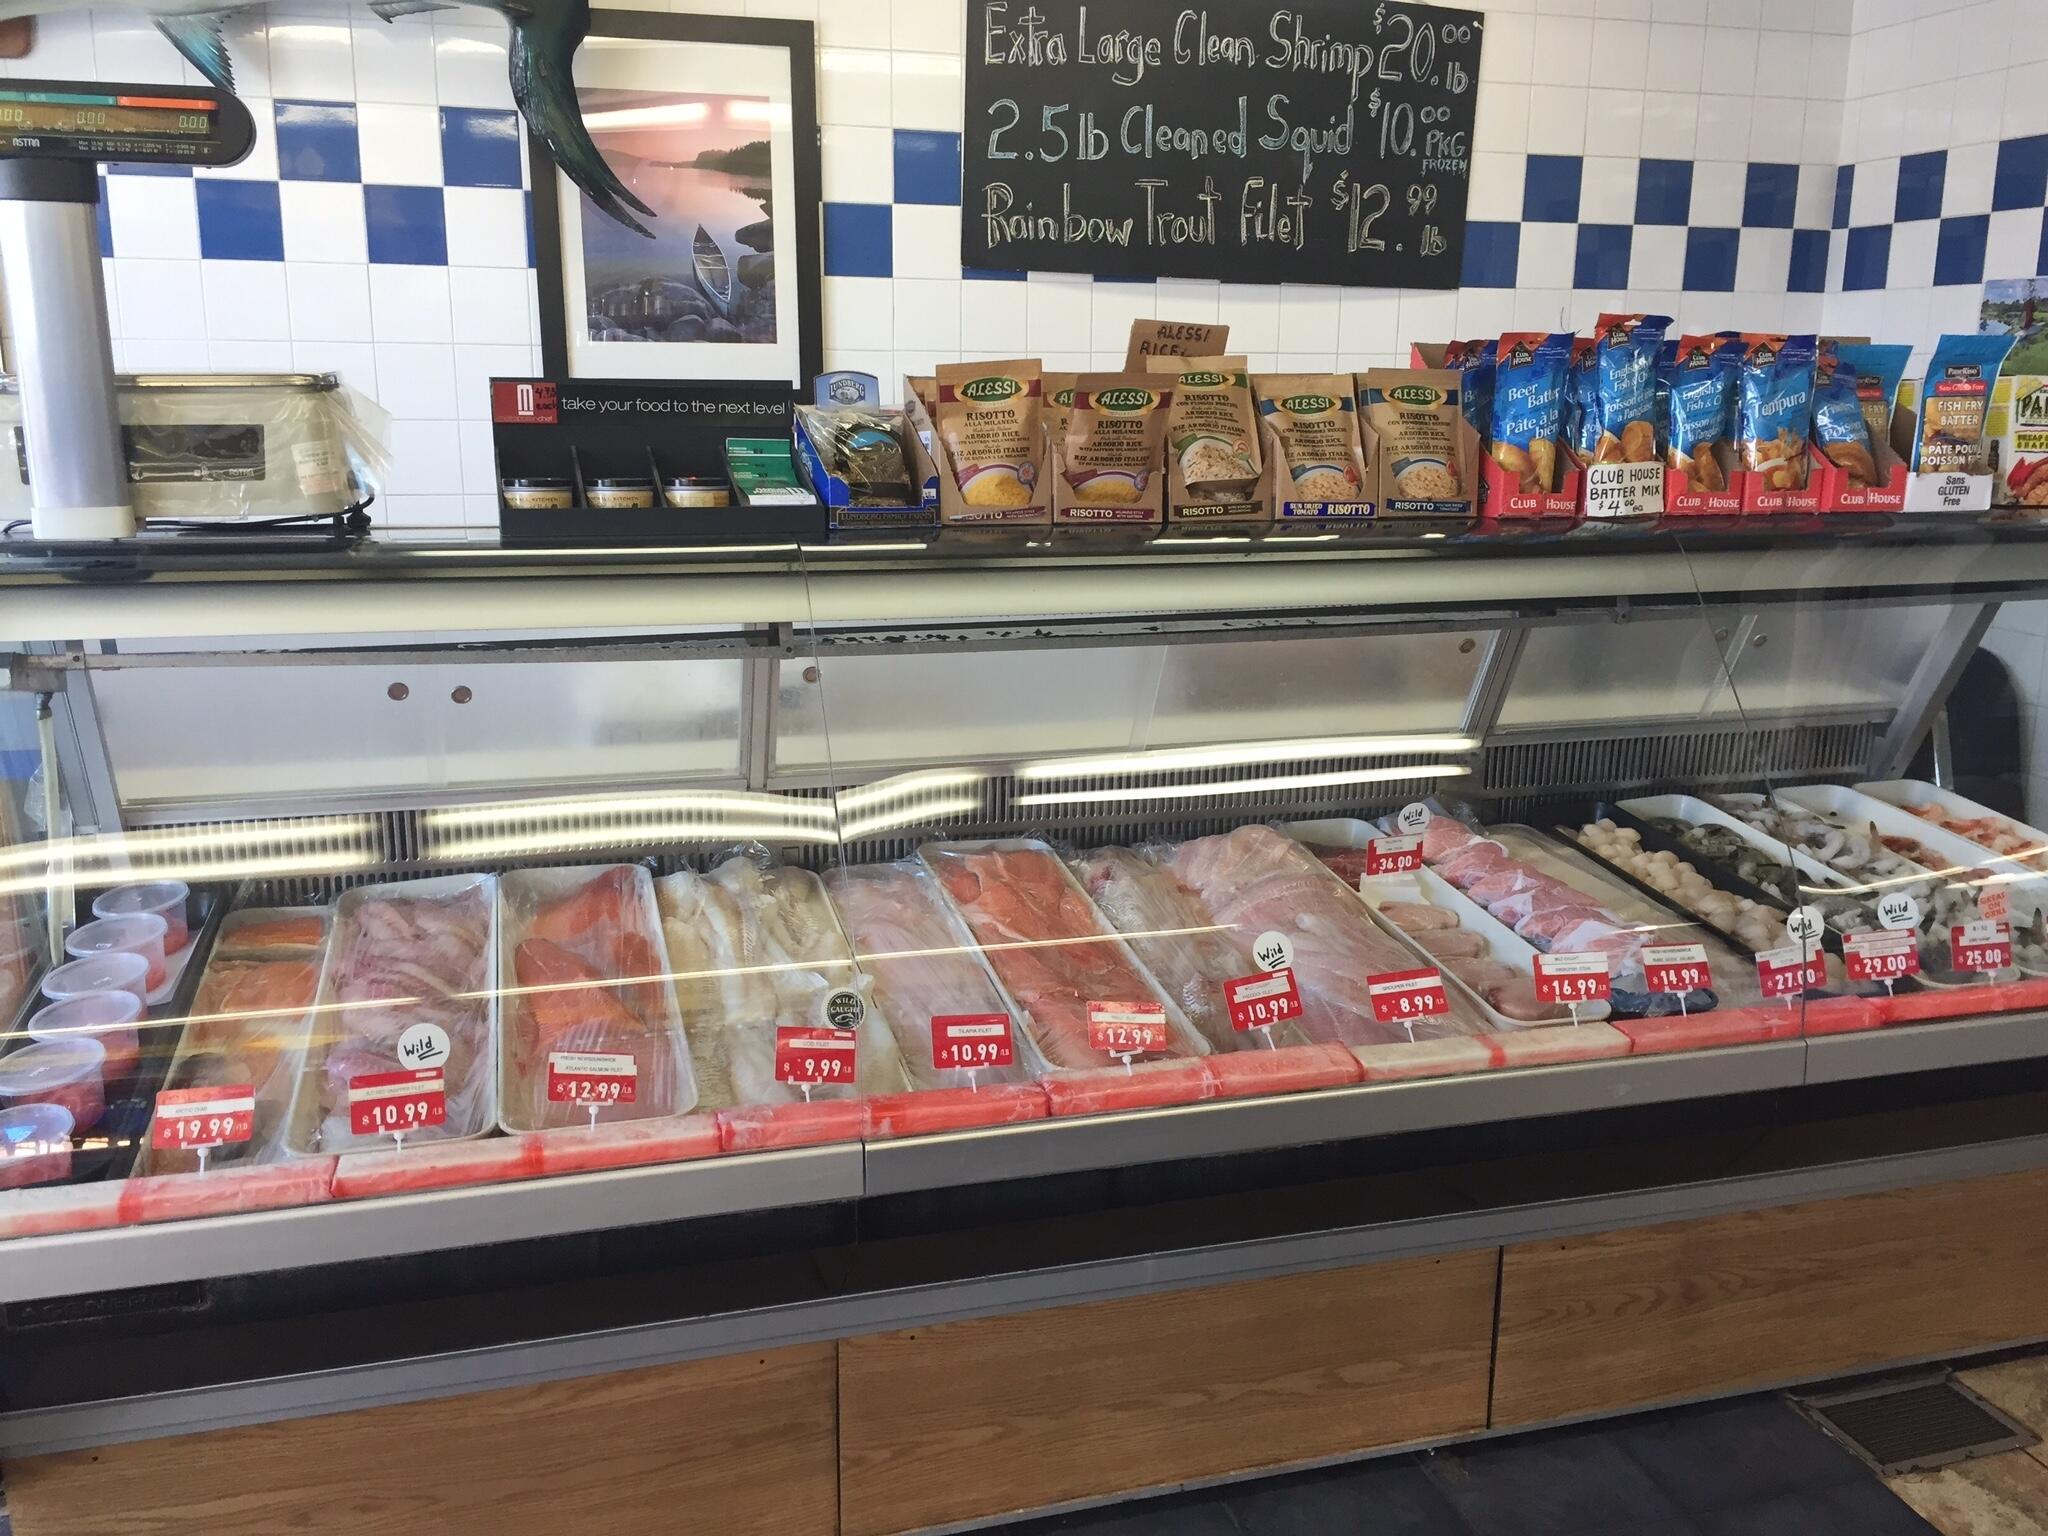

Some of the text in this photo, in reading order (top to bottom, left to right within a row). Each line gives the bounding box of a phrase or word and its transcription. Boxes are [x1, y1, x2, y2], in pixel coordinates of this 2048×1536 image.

[985, 2, 1067, 67] Extra
[1080, 6, 1160, 85] Large
[1173, 10, 1255, 68] Clean
[1265, 10, 1374, 102] Shrimp
[1446, 62, 1469, 93] lb
[1121, 96, 1248, 159] Cleaned
[1258, 94, 1354, 183] Squid
[1421, 159, 1468, 177] FROZEN
[981, 182, 1133, 250] Rainbow
[1135, 178, 1222, 247] Trout
[1240, 176, 1312, 250] Filet
[1419, 225, 1447, 256] lb
[1157, 325, 1210, 342] ALESSI
[1178, 374, 1223, 384] ALESSI
[830, 379, 865, 395] LUNDBERG
[966, 381, 1016, 396] ALESSI
[1508, 384, 1539, 402] Beer
[1101, 392, 1148, 405] ALESSI
[1184, 394, 1230, 402] RISOTTO
[1394, 389, 1435, 401] ALESSI
[1527, 387, 1561, 409] Batter
[562, 397, 785, 415] take your food to the next level
[1286, 398, 1329, 410] ALESSI
[1686, 399, 1704, 412] Fish
[1753, 391, 1806, 418] Tempura
[1938, 401, 1984, 411] FISH FRY
[966, 409, 1015, 421] RISOTTO
[1400, 413, 1439, 421] RISOTTO
[1941, 415, 1979, 426] BATTER
[1097, 420, 1143, 429] RISOTTO
[1292, 420, 1335, 429] RISOTTO
[1506, 409, 1560, 436] Pâte à la
[965, 432, 1000, 440] ARBORIO
[1928, 442, 1953, 454] PÂTE
[1920, 456, 1965, 466] POISSON
[1591, 467, 1660, 485] CLUB HOUSE
[1946, 476, 1965, 485] Sans
[1590, 484, 1660, 500] BATTER MIX
[1937, 486, 1970, 496] GLUTEN
[1510, 498, 1576, 510] CLUB HOUSE
[1676, 496, 1740, 508] CLUB HOUSE
[1757, 496, 1818, 507] CLUB HOUSE
[1840, 493, 1901, 505] CLUB HOUSE
[1943, 497, 1961, 506] Free
[1182, 506, 1224, 516] RISOTTO
[1292, 508, 1319, 516] TOMATO
[1327, 504, 1370, 515] RISOTTO
[1394, 501, 1434, 511] RISOTTO
[1069, 508, 1113, 518] RISOTTO
[1404, 808, 1423, 821] Wild
[1883, 901, 1908, 916] Wild
[1257, 943, 1284, 962] Wild
[404, 1036, 433, 1057] Wild
